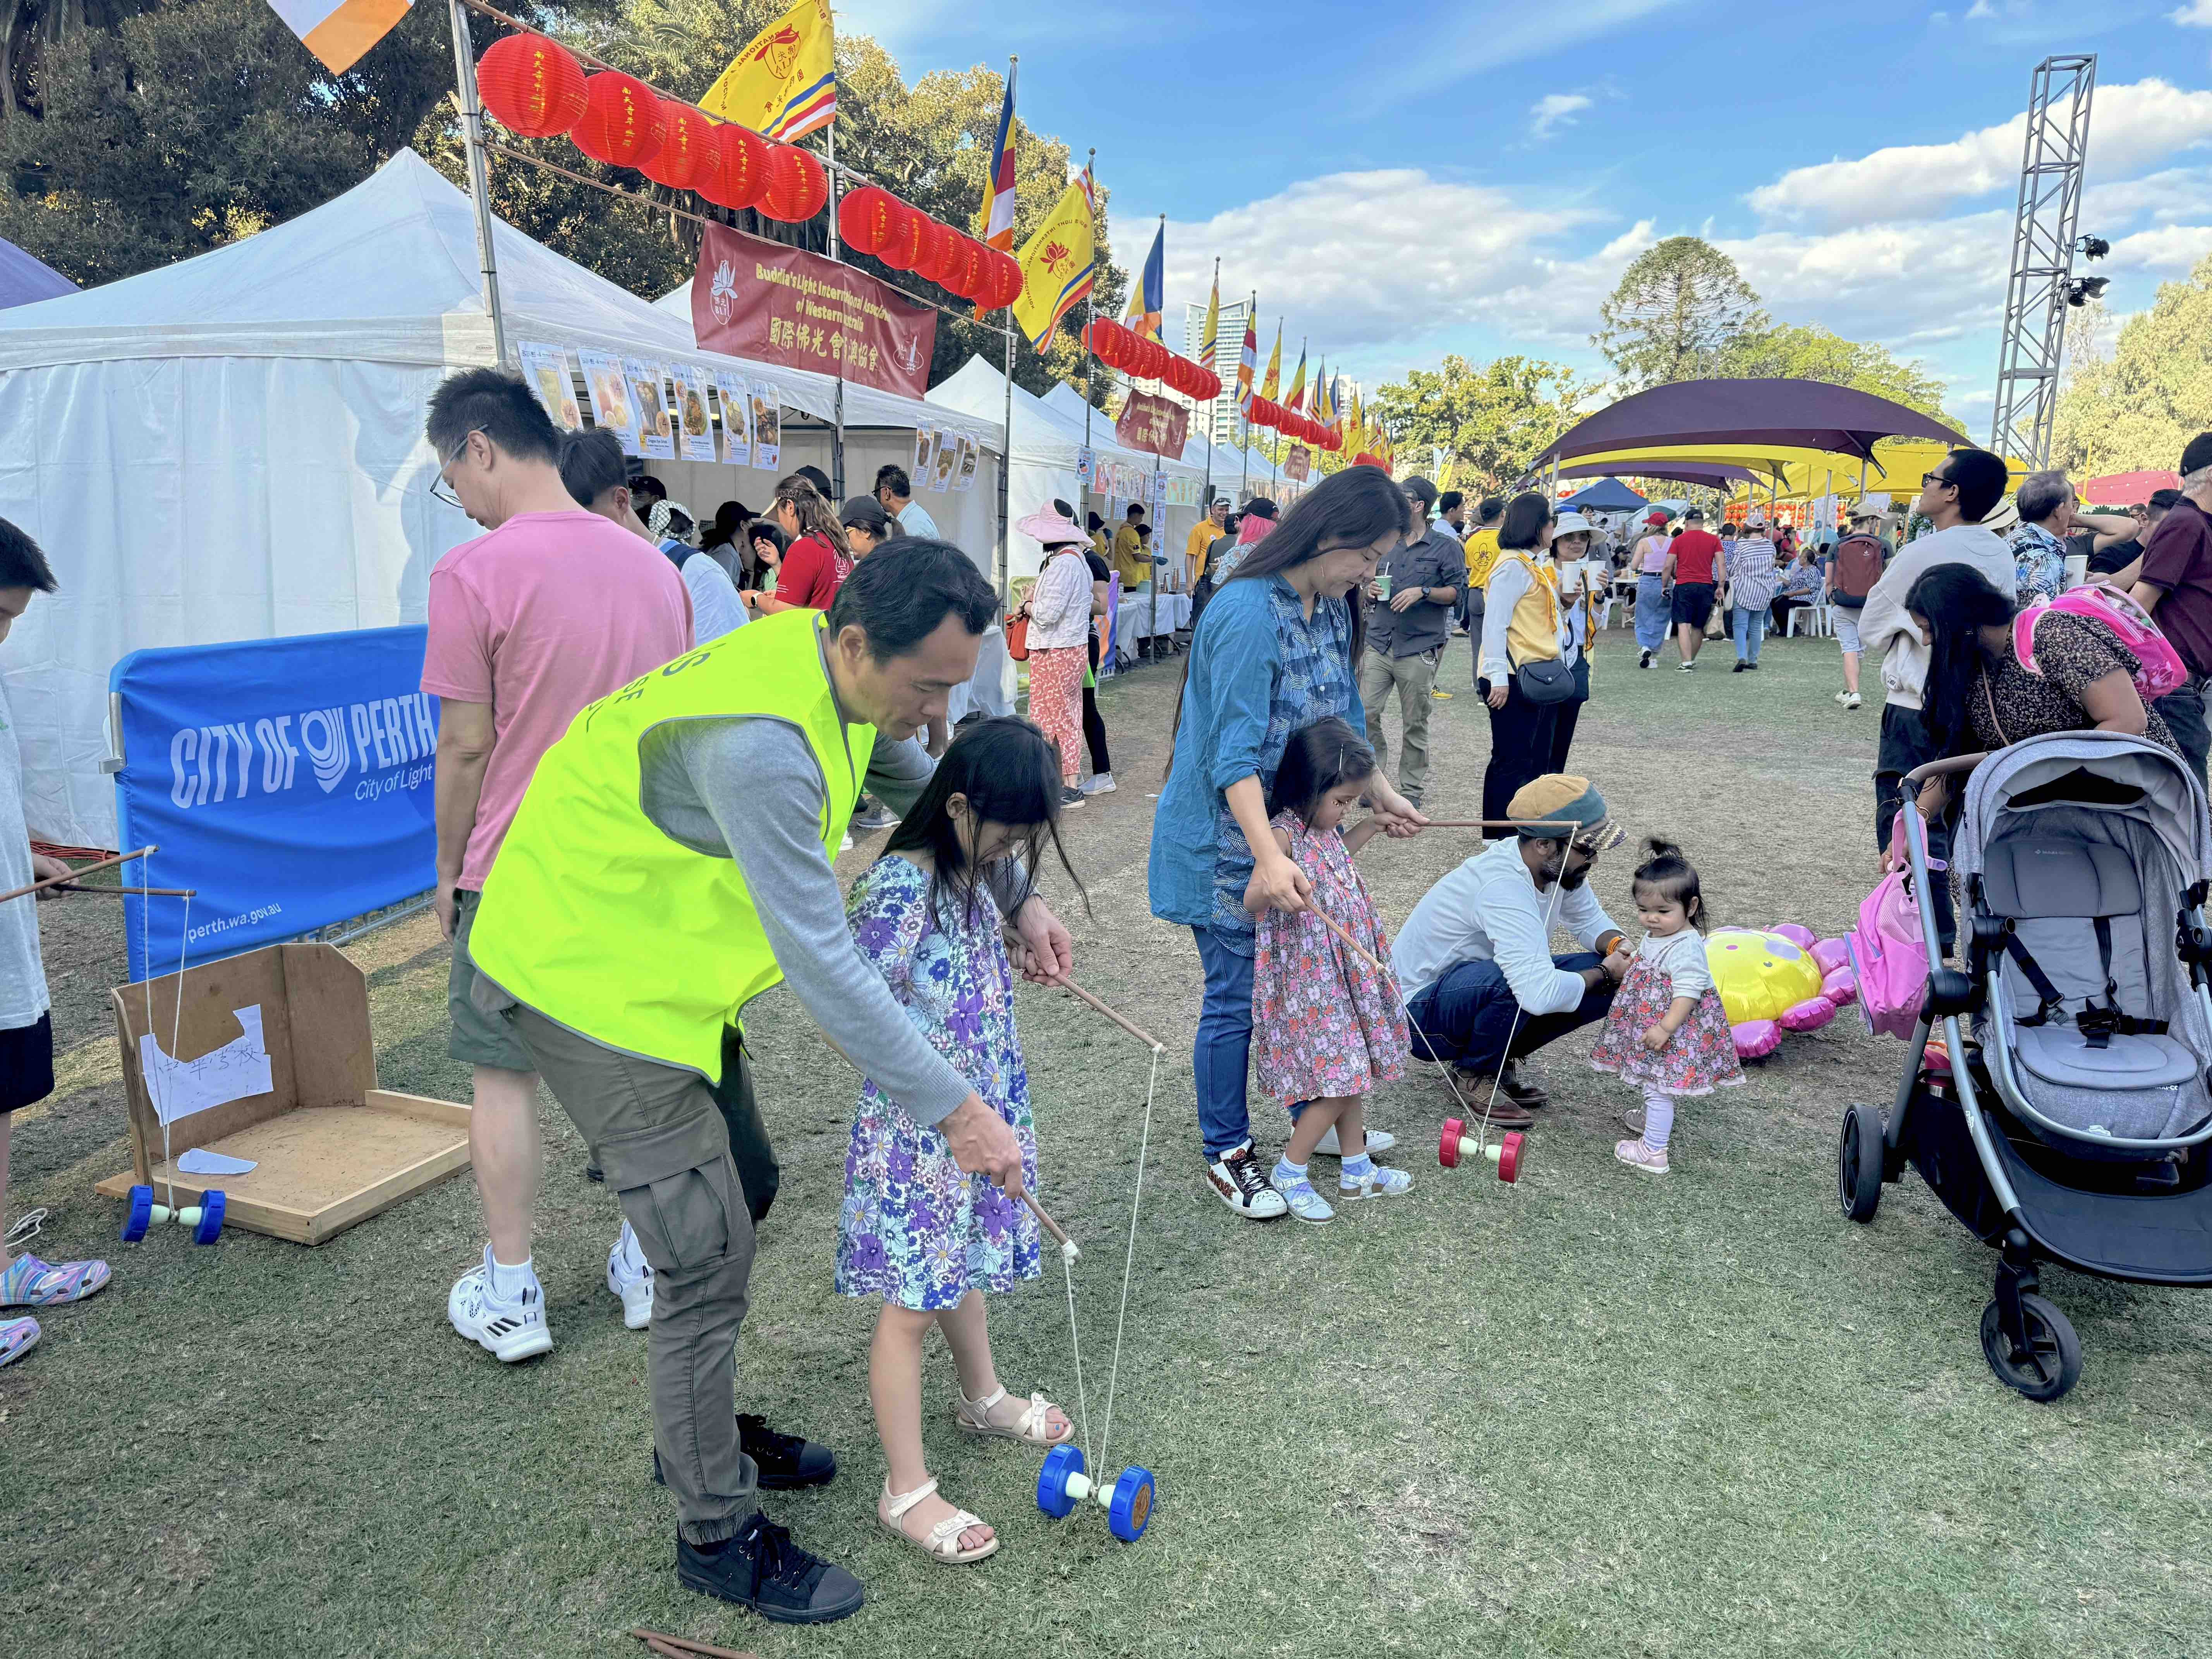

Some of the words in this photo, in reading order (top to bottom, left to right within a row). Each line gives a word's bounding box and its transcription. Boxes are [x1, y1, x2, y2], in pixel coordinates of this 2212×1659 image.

[797, 274, 817, 295] Light
[796, 297, 805, 313] of
[806, 299, 843, 323] Western
[843, 314, 864, 332] ustralia
[770, 317, 878, 372] 國際佛光會澳協會
[170, 721, 253, 809] CITY
[255, 715, 300, 793] OF
[351, 692, 437, 774] PERTH
[354, 776, 384, 801] City
[385, 772, 400, 793] of
[400, 763, 433, 792] Light
[188, 902, 282, 943] perth.wa.gov.au
